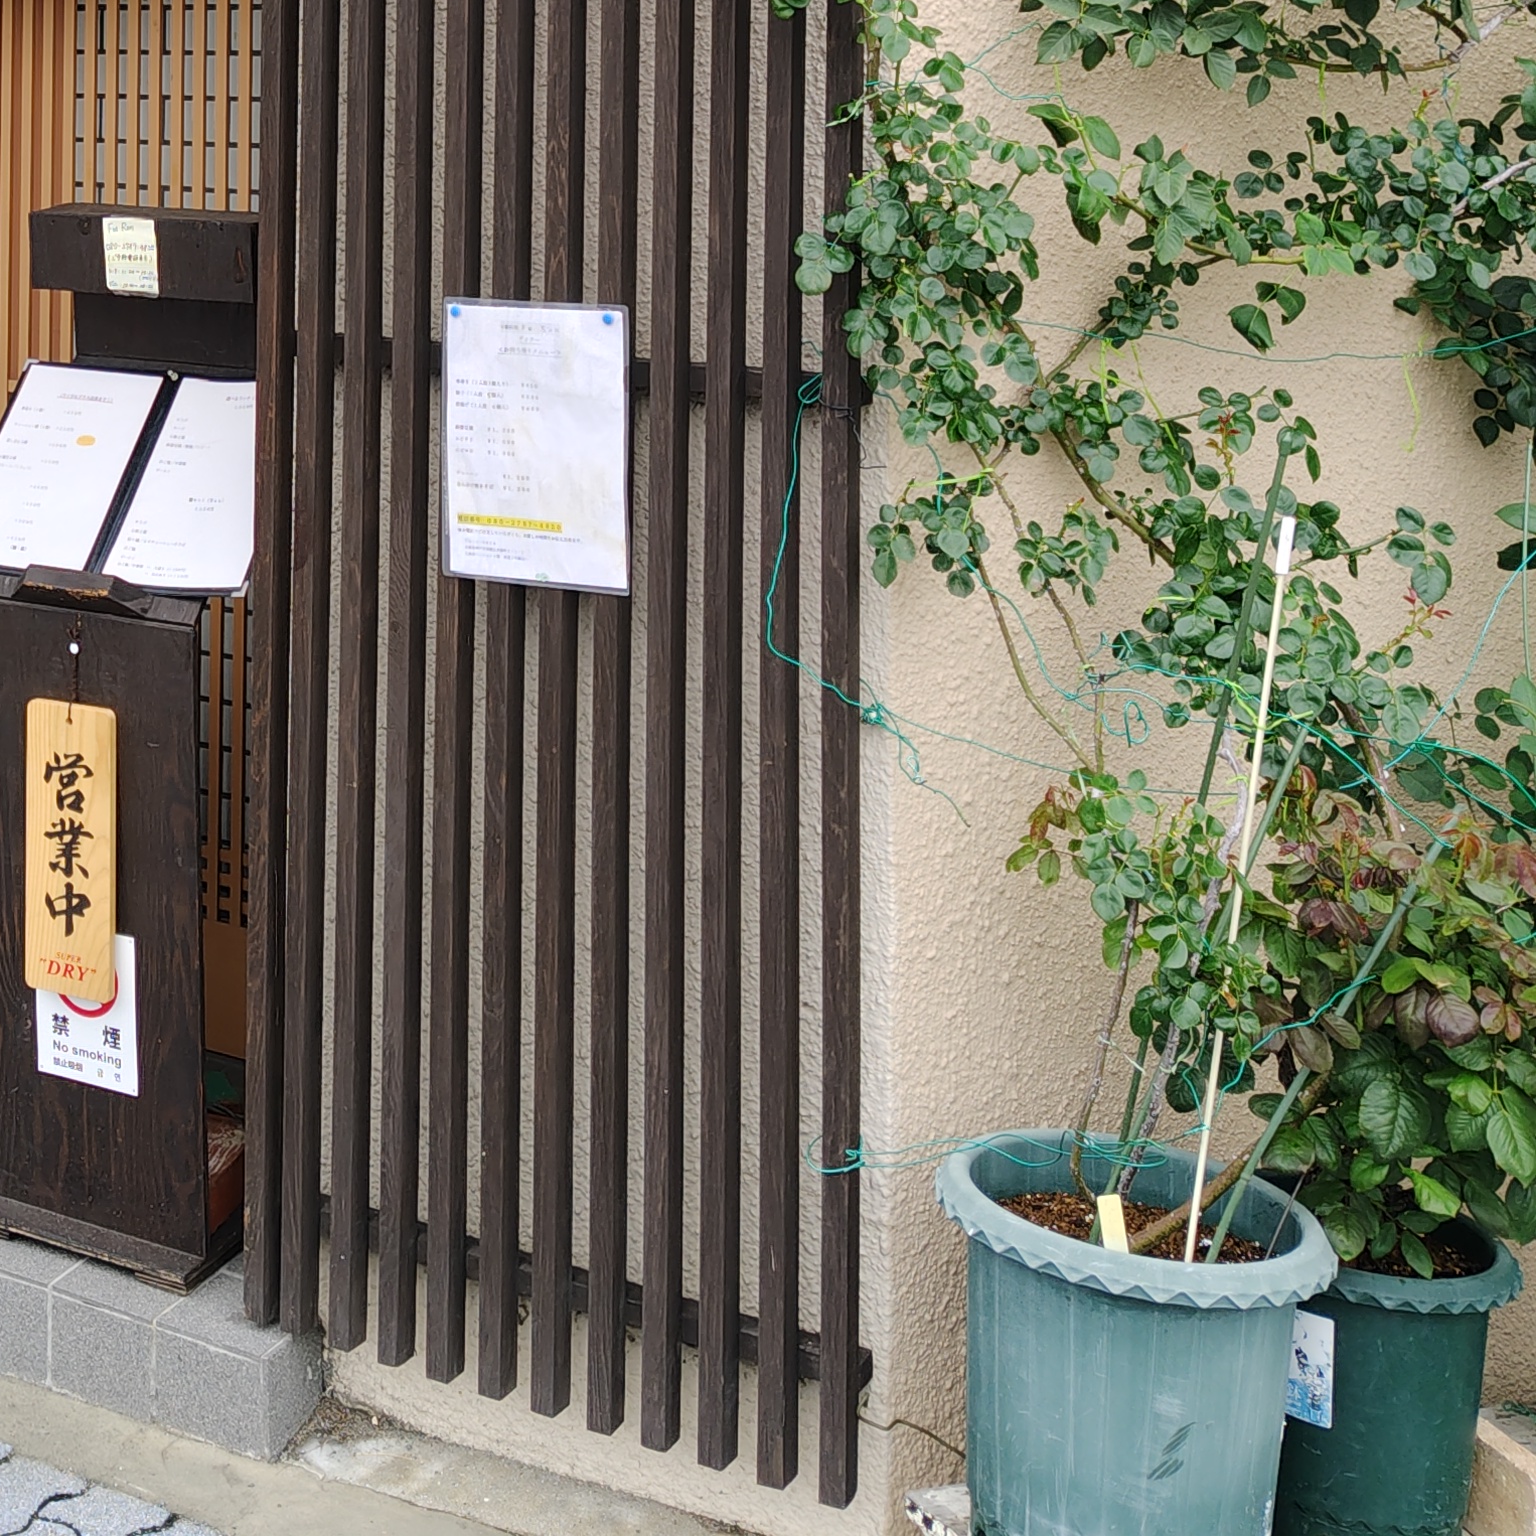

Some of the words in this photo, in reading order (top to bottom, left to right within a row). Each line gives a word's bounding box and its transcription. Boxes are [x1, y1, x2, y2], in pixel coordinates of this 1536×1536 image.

[42, 750, 95, 939] 営業中
[55, 951, 83, 964] SUPER
[52, 1039, 69, 1053] No
[71, 1046, 122, 1070] smoking
